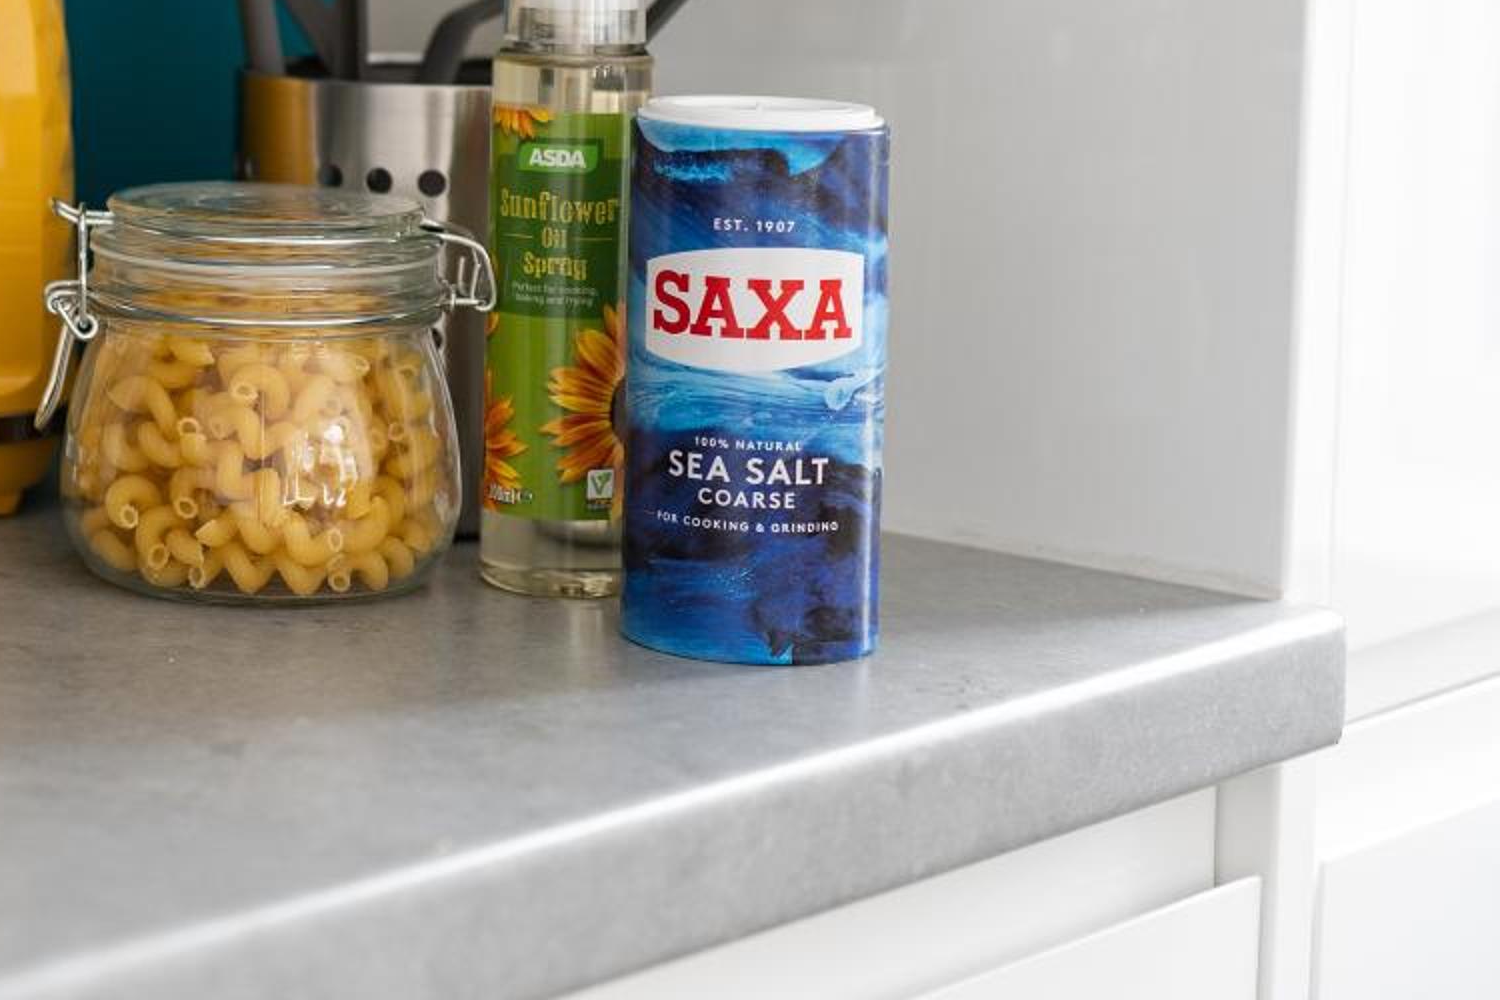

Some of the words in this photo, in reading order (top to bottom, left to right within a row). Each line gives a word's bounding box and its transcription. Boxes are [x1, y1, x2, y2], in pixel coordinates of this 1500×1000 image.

[529, 148, 586, 168] ASDA
[501, 187, 620, 224] Sunflower
[713, 217, 749, 232] EST.
[756, 219, 796, 233] 1907
[541, 226, 568, 249] Oil
[523, 251, 588, 281] Spray
[653, 269, 853, 340] SAXA
[695, 436, 729, 449] 100%
[735, 440, 802, 451] NATURAL
[668, 450, 731, 483] SEA
[745, 457, 829, 485] SALT
[698, 487, 797, 509] COARSE
[657, 509, 679, 523] FOR
[683, 515, 750, 533] COOKING
[755, 520, 766, 533] &
[771, 520, 839, 534] GRINDING
